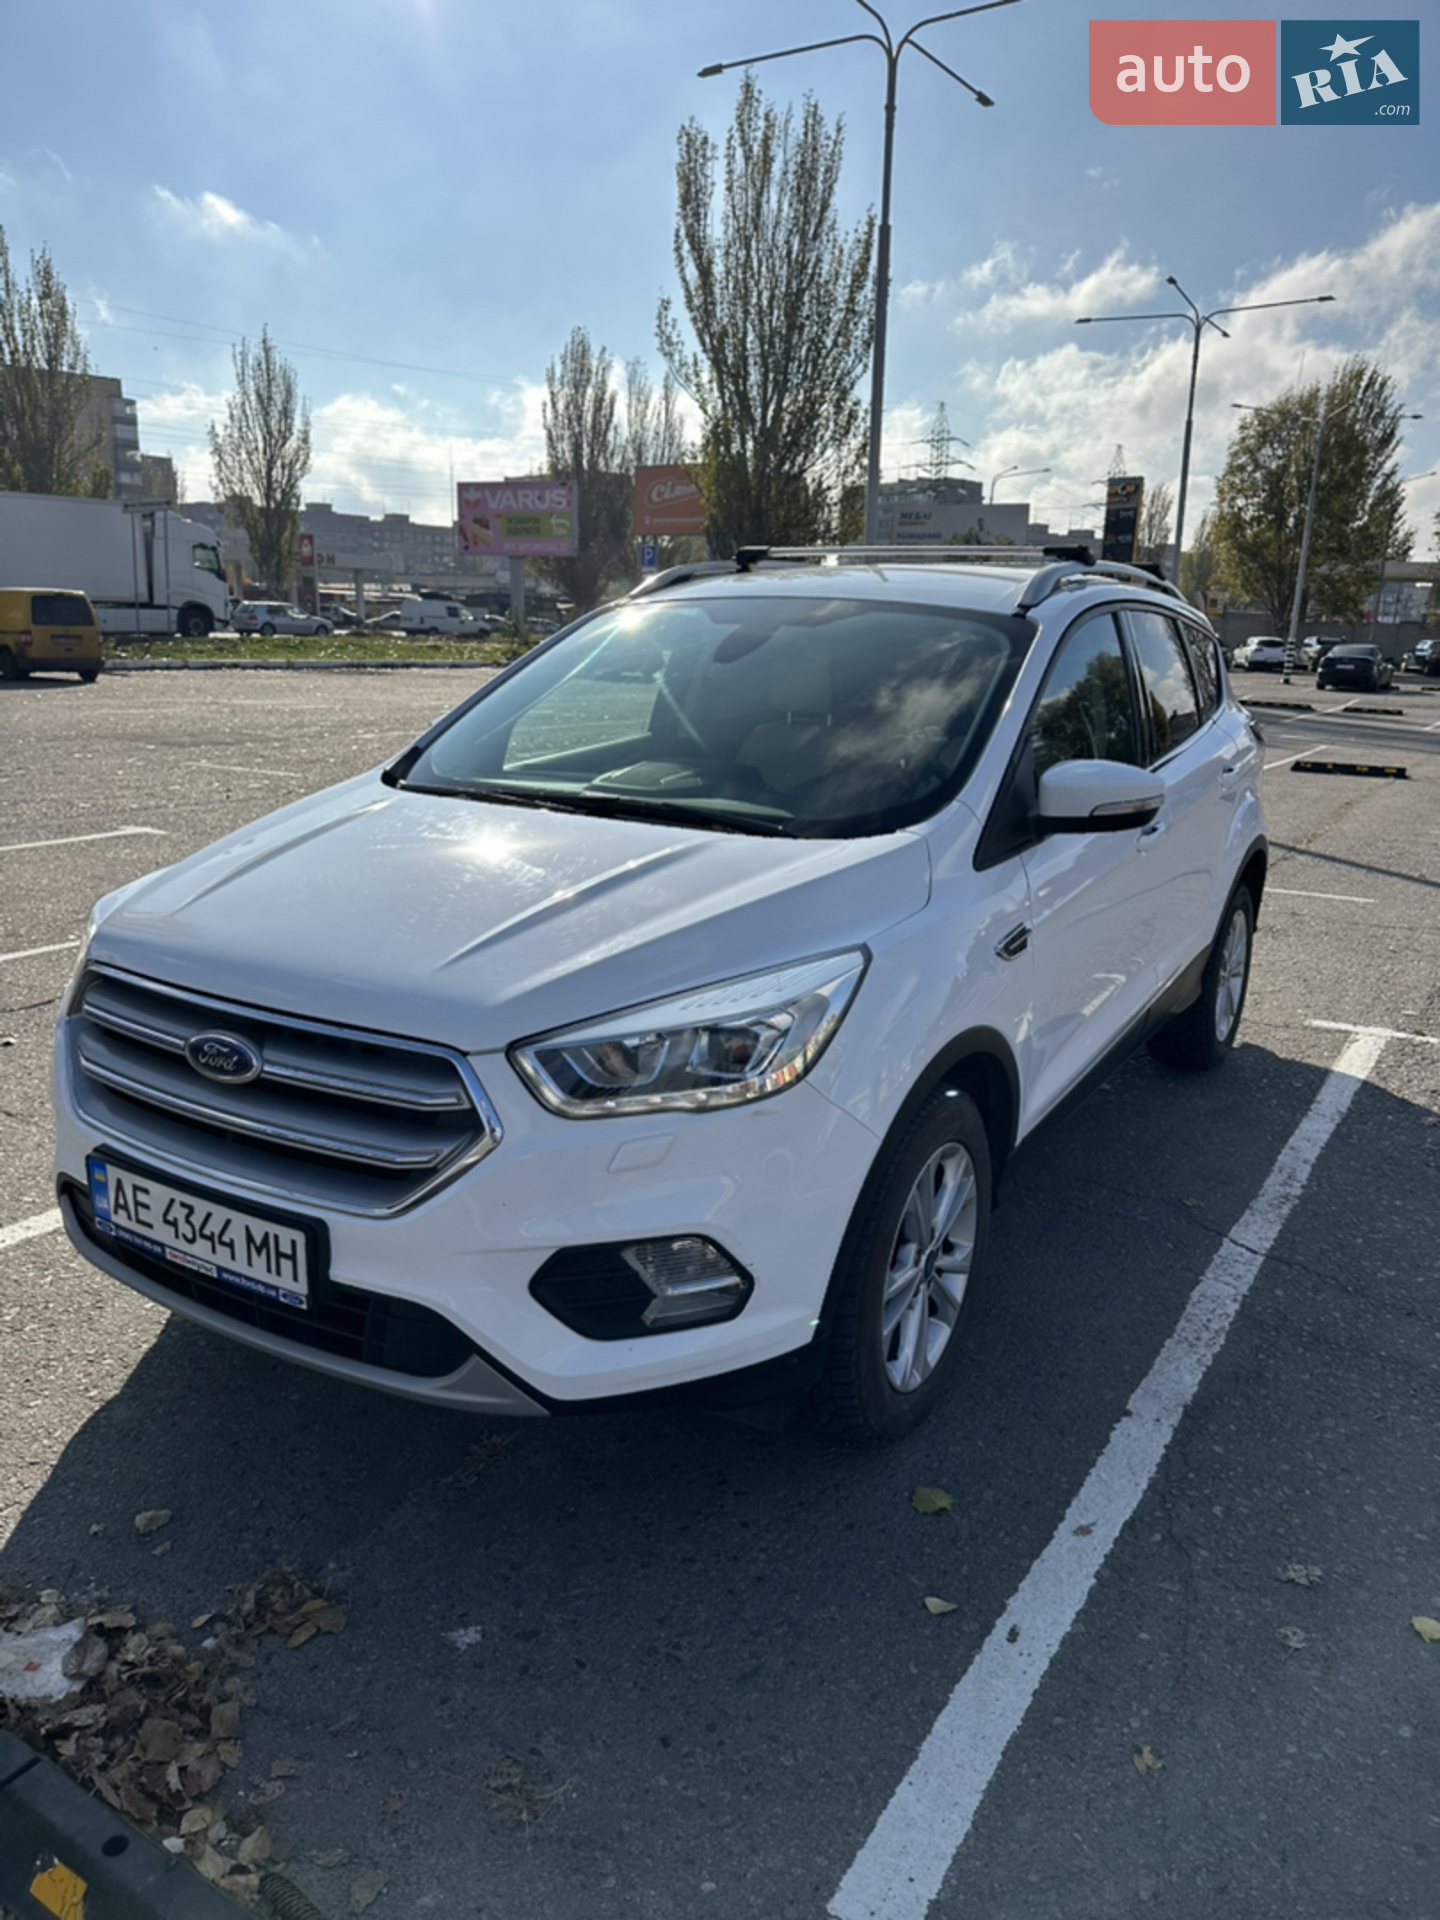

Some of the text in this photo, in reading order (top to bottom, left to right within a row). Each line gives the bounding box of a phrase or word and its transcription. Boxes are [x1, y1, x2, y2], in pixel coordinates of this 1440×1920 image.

[484, 489, 567, 510] VARUS
[198, 1041, 239, 1072] Ford
[113, 1177, 154, 1230] AE
[162, 1197, 236, 1262] 4344
[245, 1224, 299, 1283] MH
